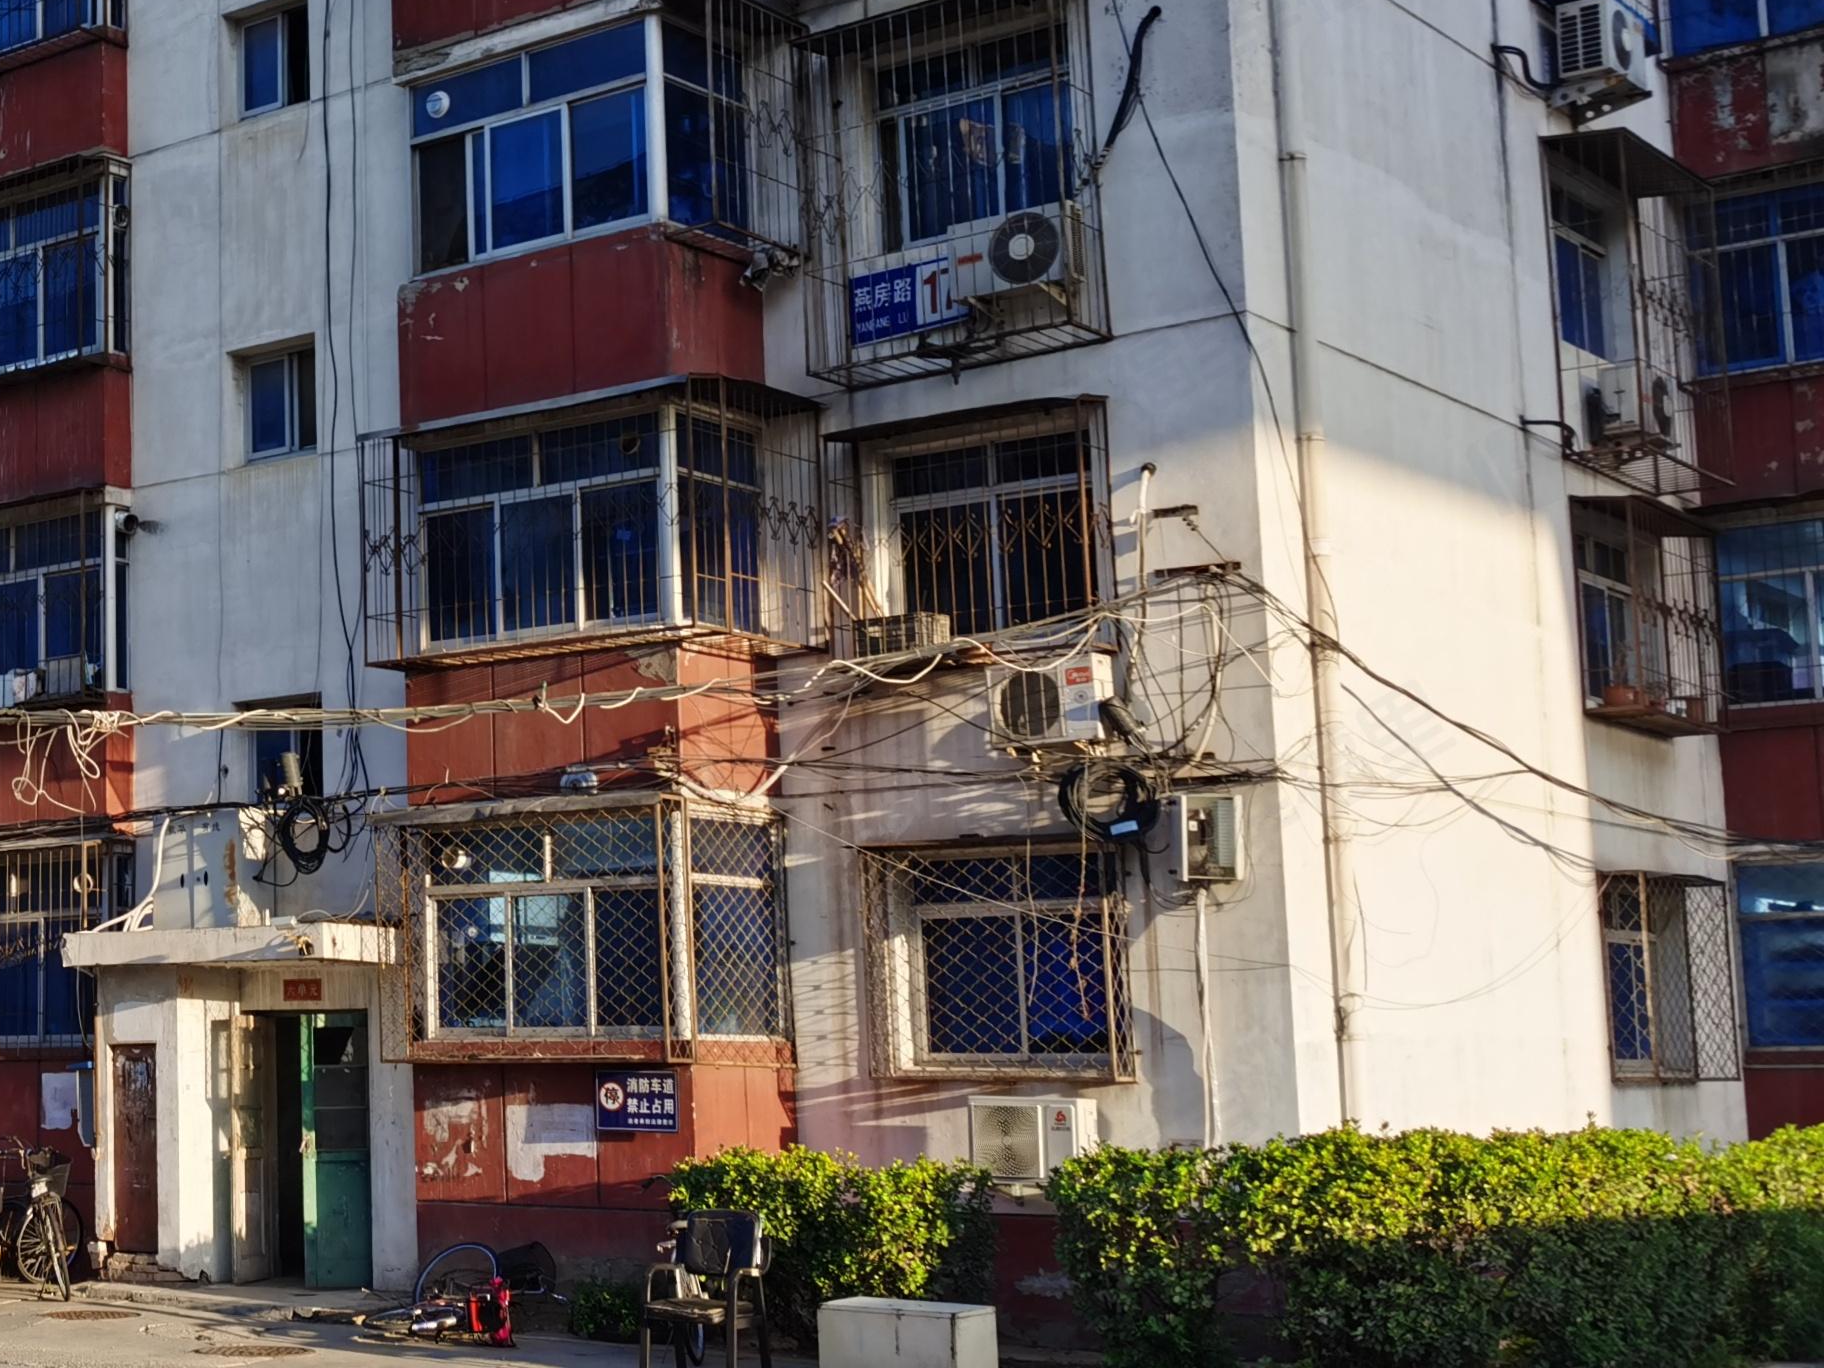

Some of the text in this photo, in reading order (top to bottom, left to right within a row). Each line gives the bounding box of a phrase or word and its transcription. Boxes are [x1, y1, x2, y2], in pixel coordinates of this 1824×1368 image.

[854, 278, 912, 312] 燕房路
[626, 1078, 674, 1094] 消防车道
[626, 1098, 674, 1114] 禁止占用
